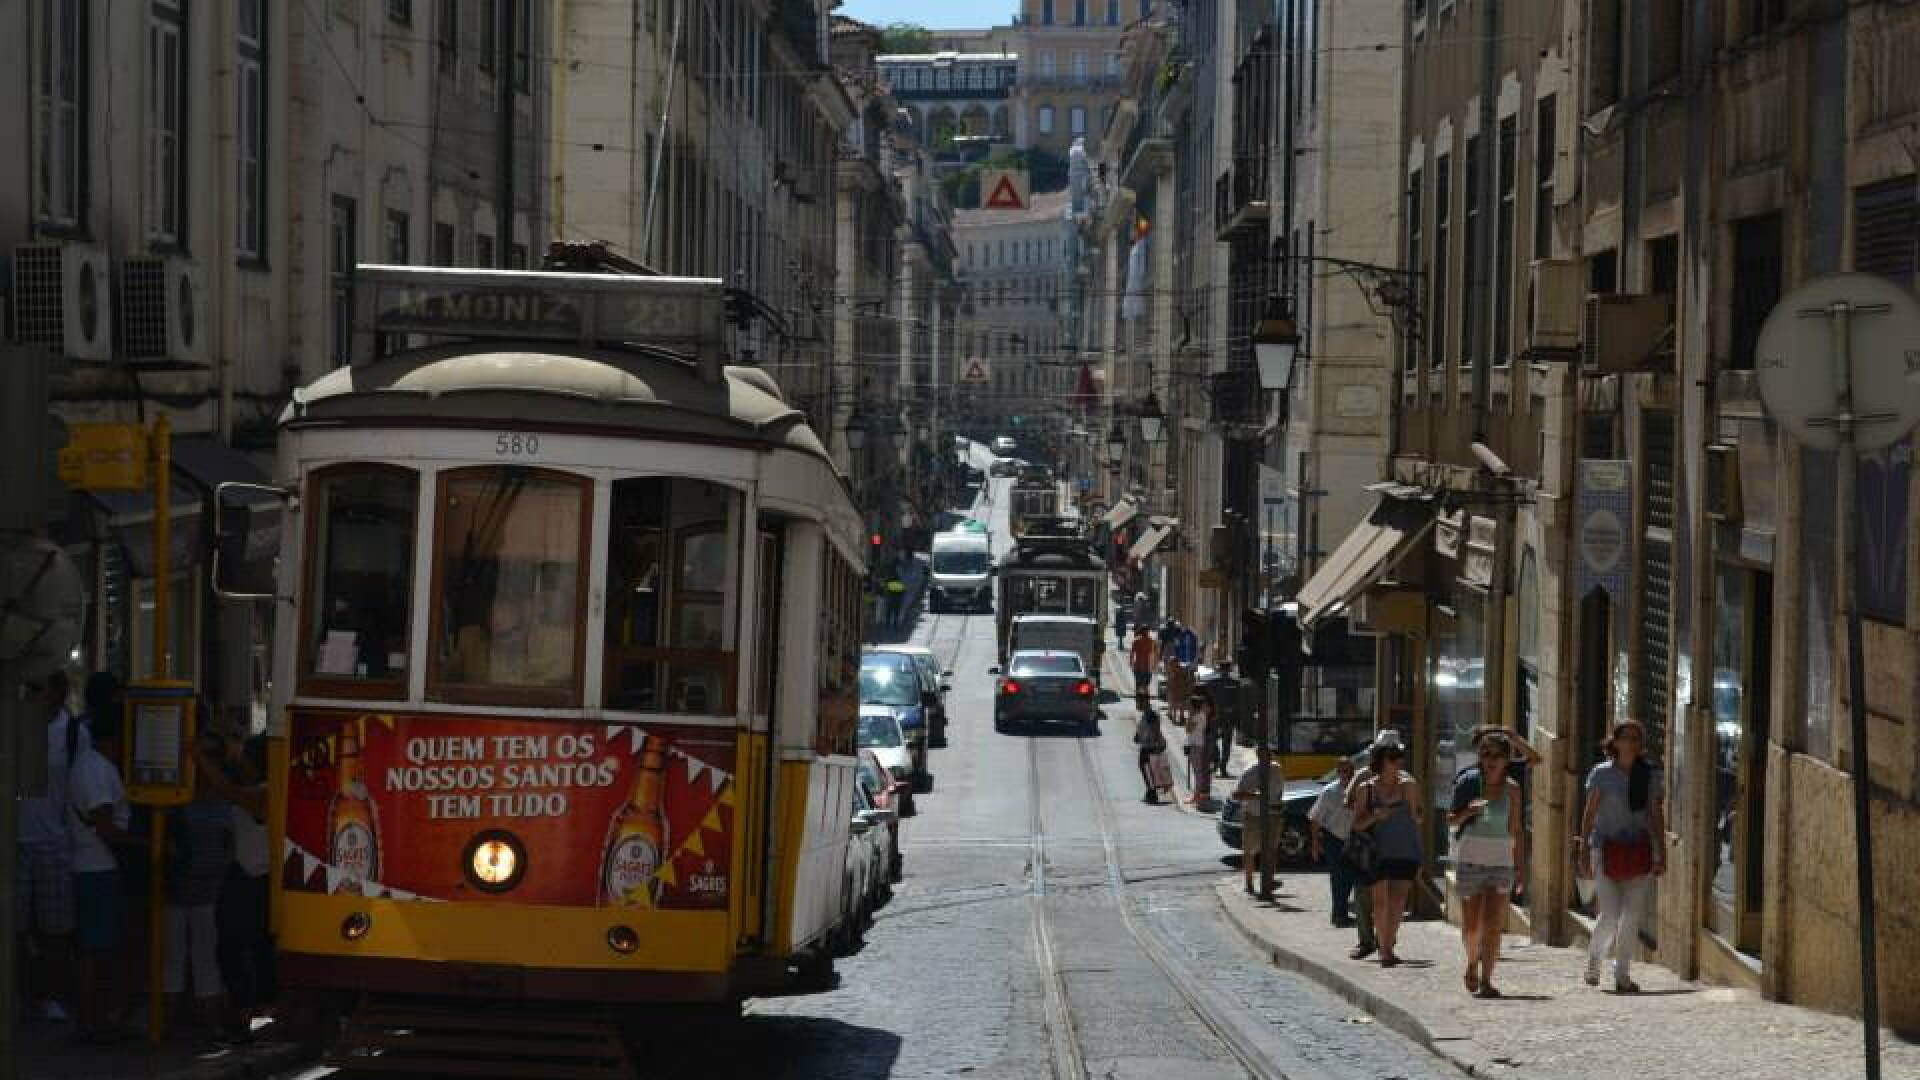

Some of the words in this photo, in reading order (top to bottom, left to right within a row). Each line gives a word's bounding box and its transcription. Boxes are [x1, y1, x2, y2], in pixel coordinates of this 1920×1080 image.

[443, 291, 569, 322] MONIZ
[624, 296, 681, 335] 28
[495, 432, 540, 455] 580
[406, 736, 485, 765] QUEM
[491, 736, 548, 760] TEM
[556, 734, 595, 759] OS
[385, 766, 495, 791] NOSSOS
[503, 761, 615, 787] SANTOS
[426, 795, 482, 819] TEM
[488, 793, 569, 817] TUDO
